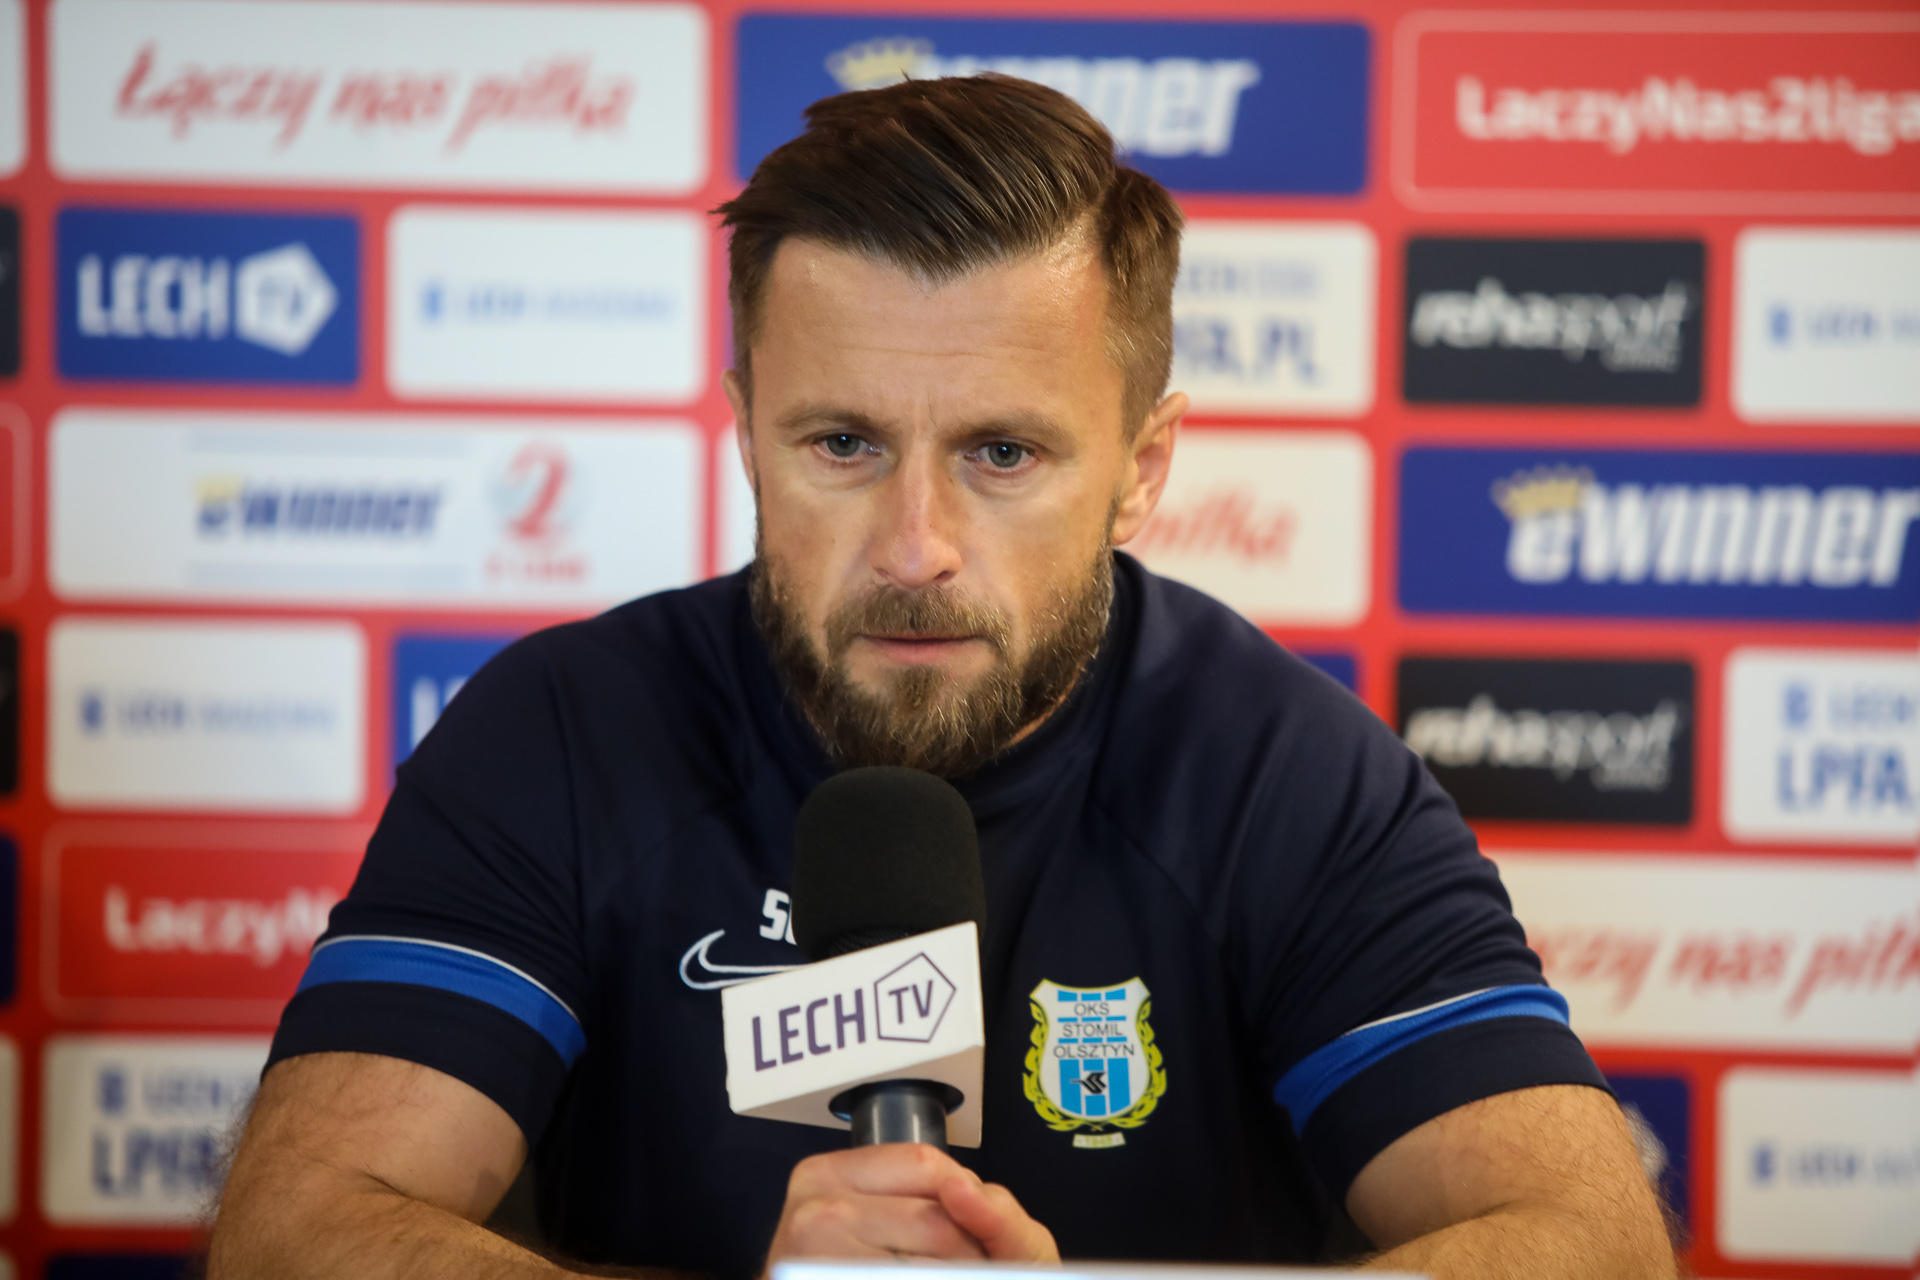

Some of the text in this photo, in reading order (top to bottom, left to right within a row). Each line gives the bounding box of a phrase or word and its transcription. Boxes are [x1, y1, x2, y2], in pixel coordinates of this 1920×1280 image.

[76, 253, 231, 338] LECH
[1074, 1002, 1109, 1016] OKS
[752, 979, 933, 1072] LECH TV
[1062, 1023, 1123, 1037] STOMIL
[1053, 1044, 1134, 1059] OLSZTYN
